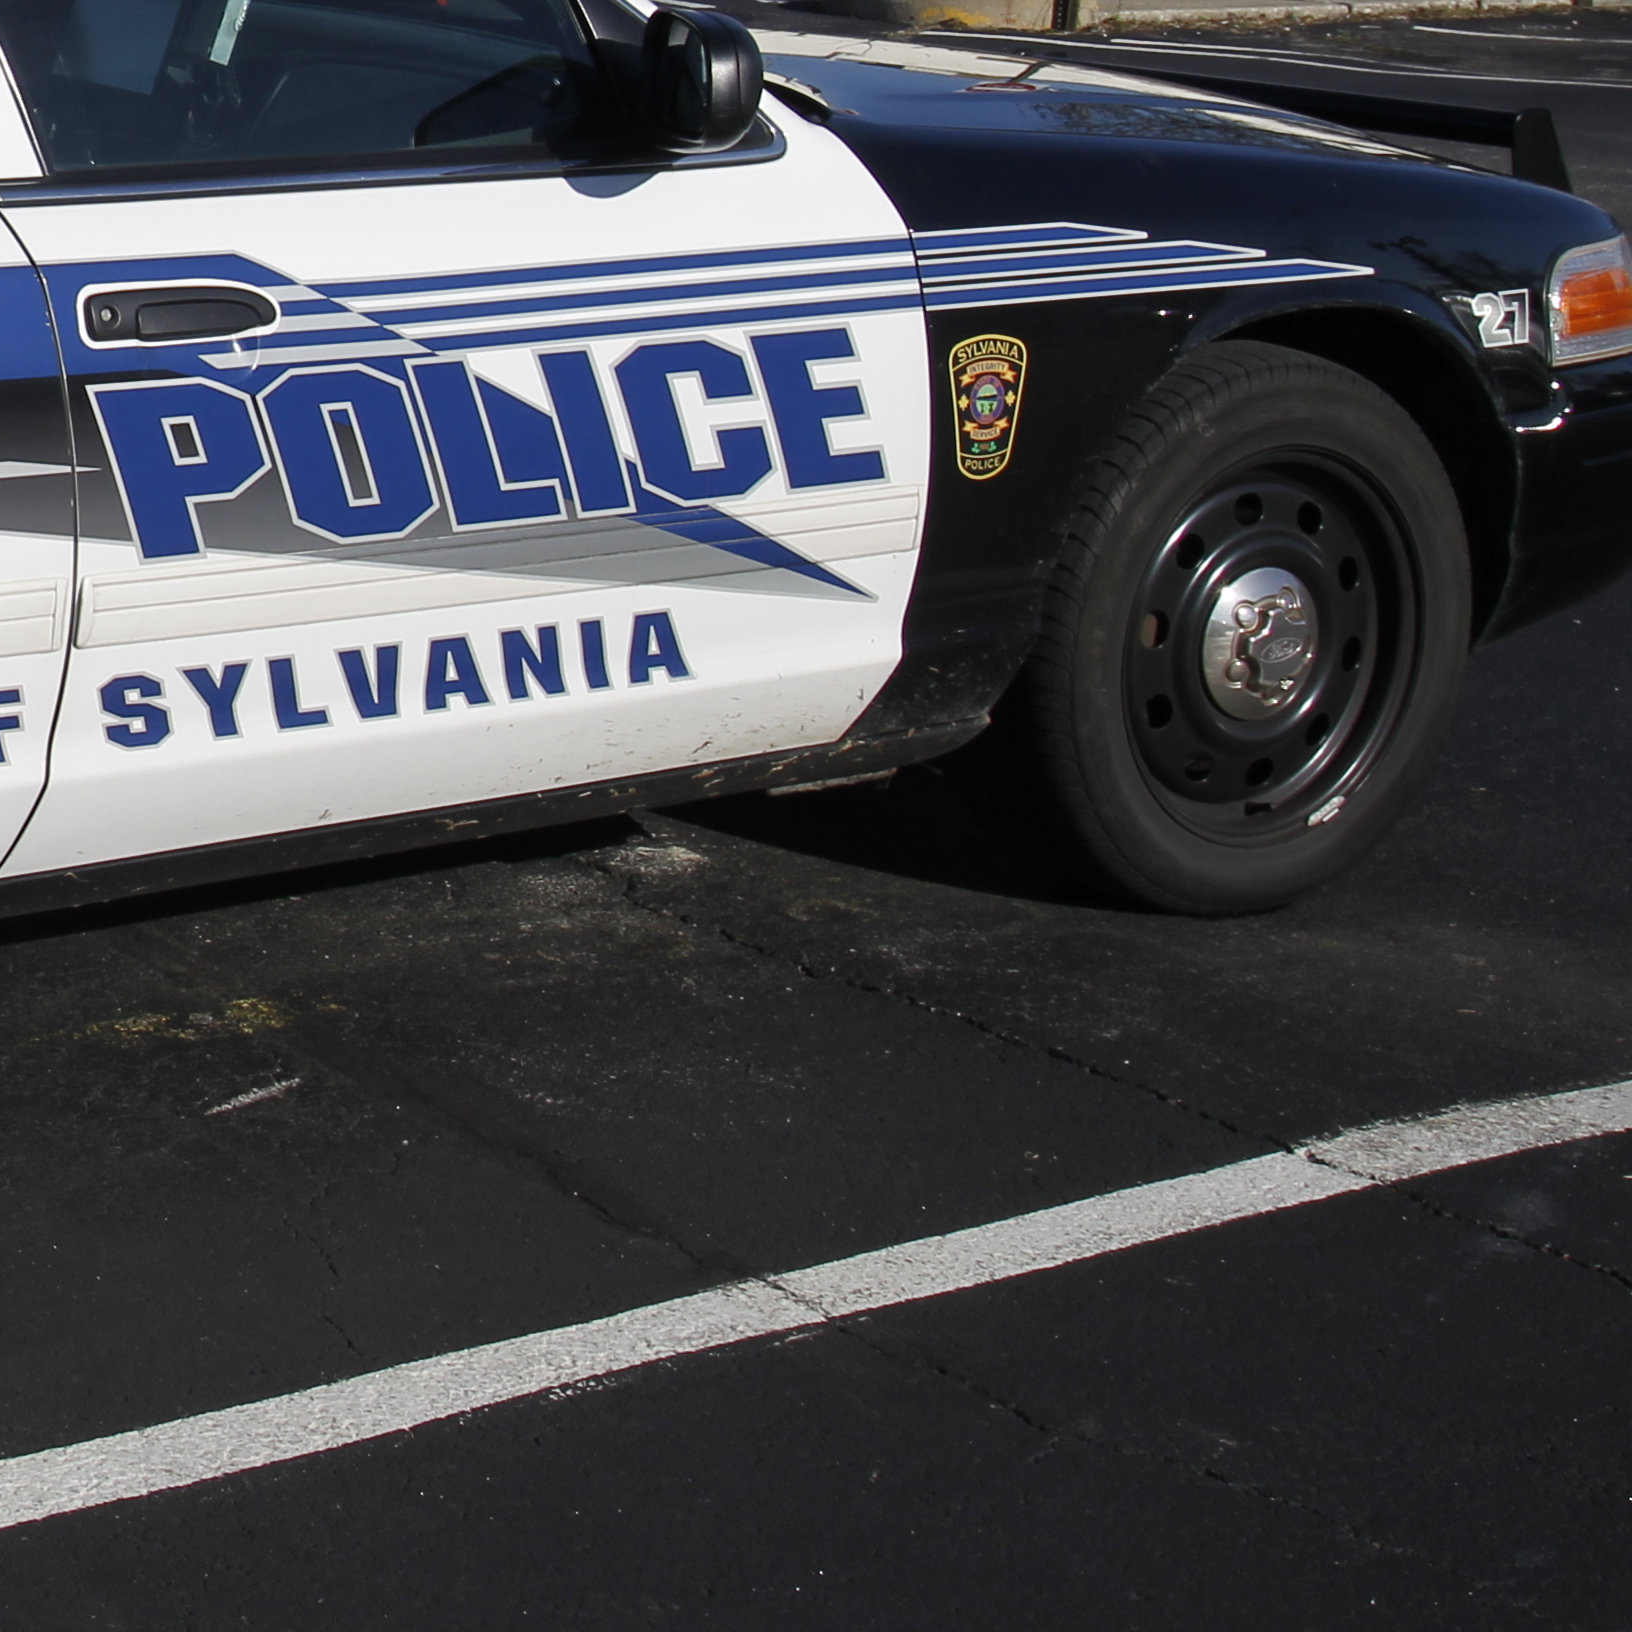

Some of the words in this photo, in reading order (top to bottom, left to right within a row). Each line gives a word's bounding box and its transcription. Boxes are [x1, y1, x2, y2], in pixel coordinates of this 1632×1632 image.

[957, 340, 1019, 363] SYLVANIA
[968, 361, 1006, 374] INTEGRITY
[84, 323, 891, 565] POLICE
[964, 456, 1001, 470] POLICE
[98, 608, 698, 752] SYLVANIA
